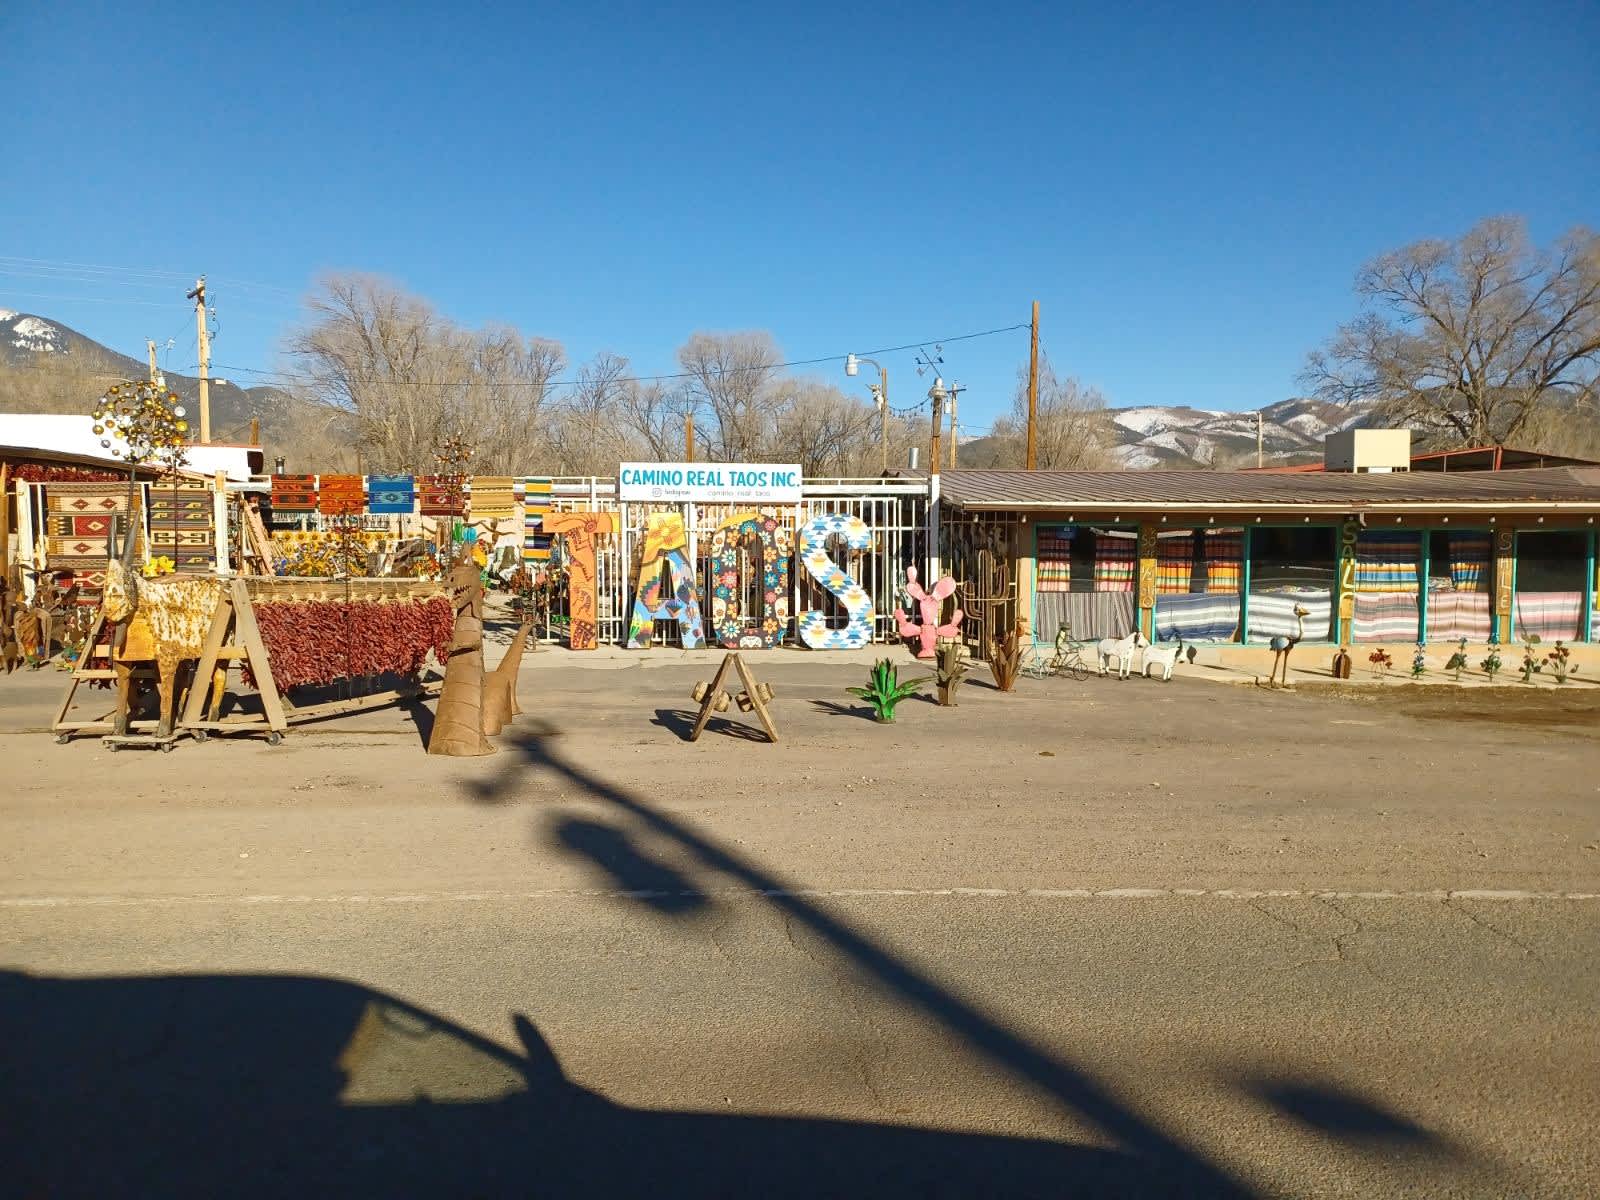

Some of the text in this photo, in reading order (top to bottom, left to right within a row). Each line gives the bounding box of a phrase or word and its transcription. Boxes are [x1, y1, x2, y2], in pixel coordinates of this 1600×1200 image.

[622, 469, 800, 488] CAMINO REAL TAOS INC.
[543, 512, 874, 650] TAOS
